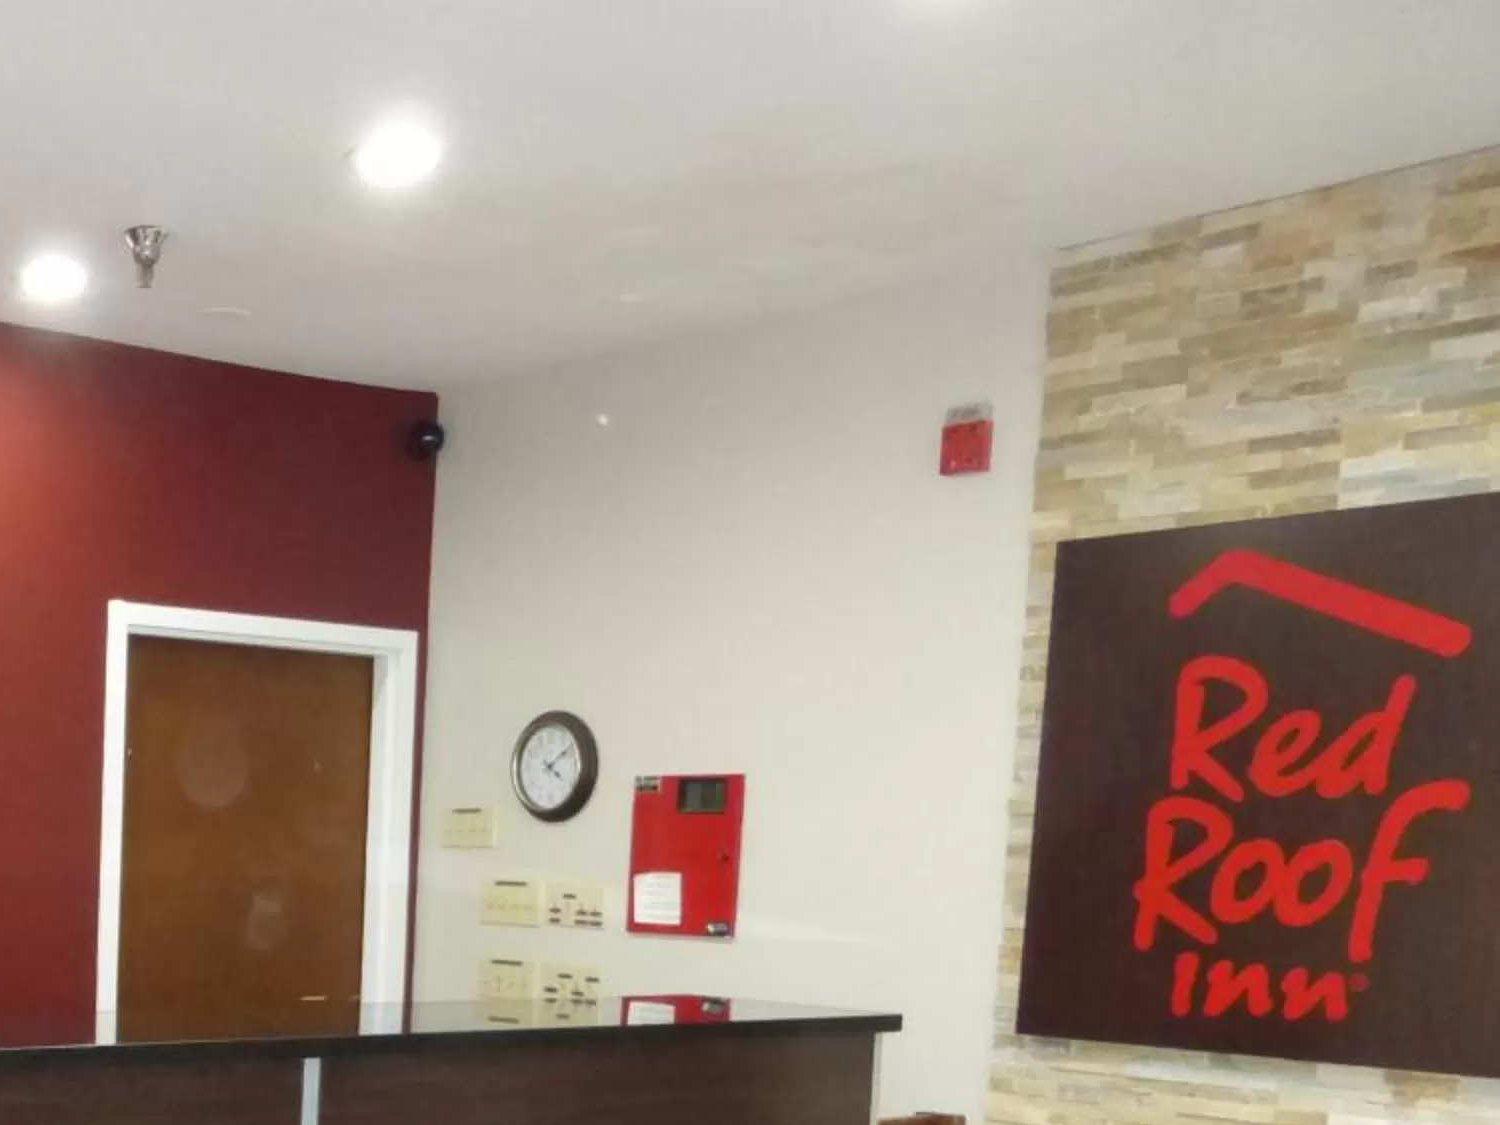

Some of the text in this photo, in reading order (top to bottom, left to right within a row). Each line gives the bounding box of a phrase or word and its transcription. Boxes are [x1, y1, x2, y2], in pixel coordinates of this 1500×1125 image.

[1169, 655, 1417, 802] Red
[1133, 779, 1471, 963] Roof
[1171, 951, 1349, 1021] Inn
